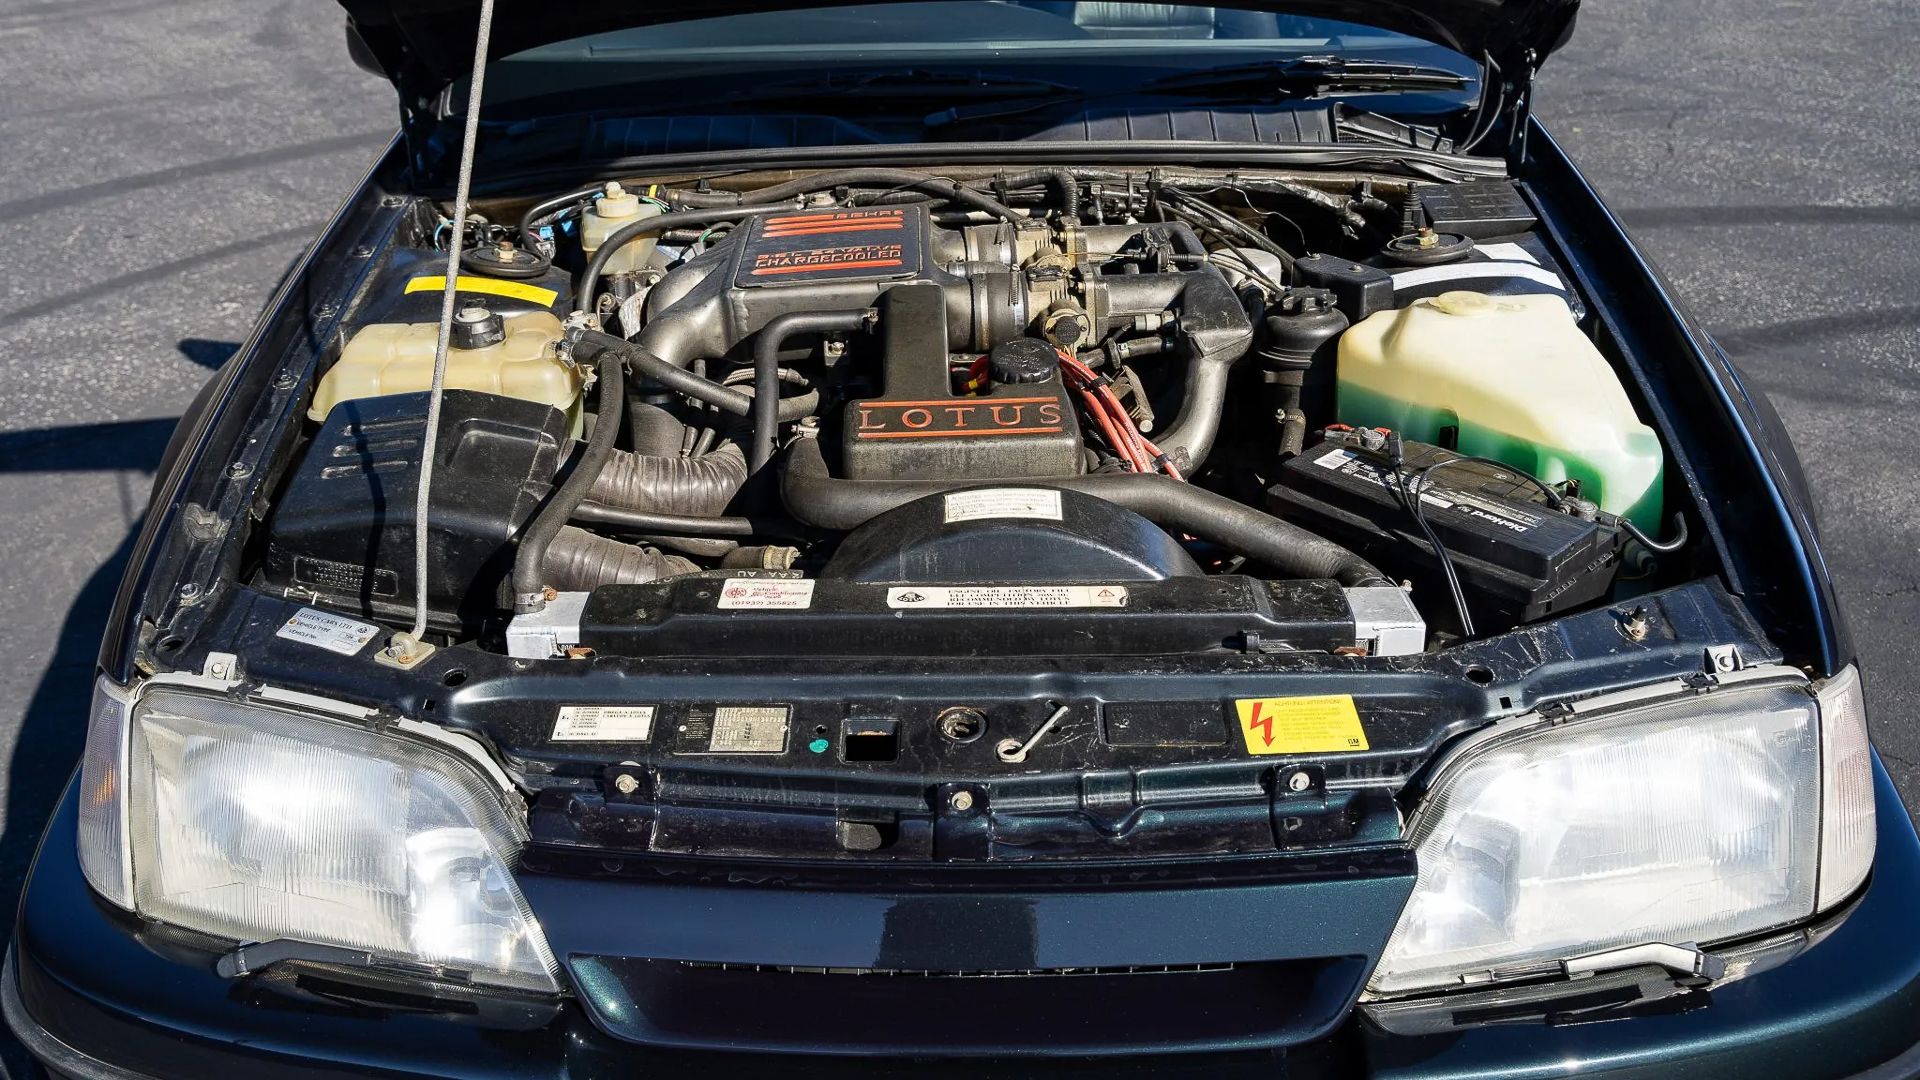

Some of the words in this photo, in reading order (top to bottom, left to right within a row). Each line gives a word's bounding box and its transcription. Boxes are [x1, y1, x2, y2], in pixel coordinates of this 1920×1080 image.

[755, 250, 901, 267] CHARGECOOLED
[859, 404, 1061, 429] LOTUS
[1470, 510, 1528, 532] DieHard
[299, 612, 321, 622] LOTUS
[321, 617, 338, 626] CARS
